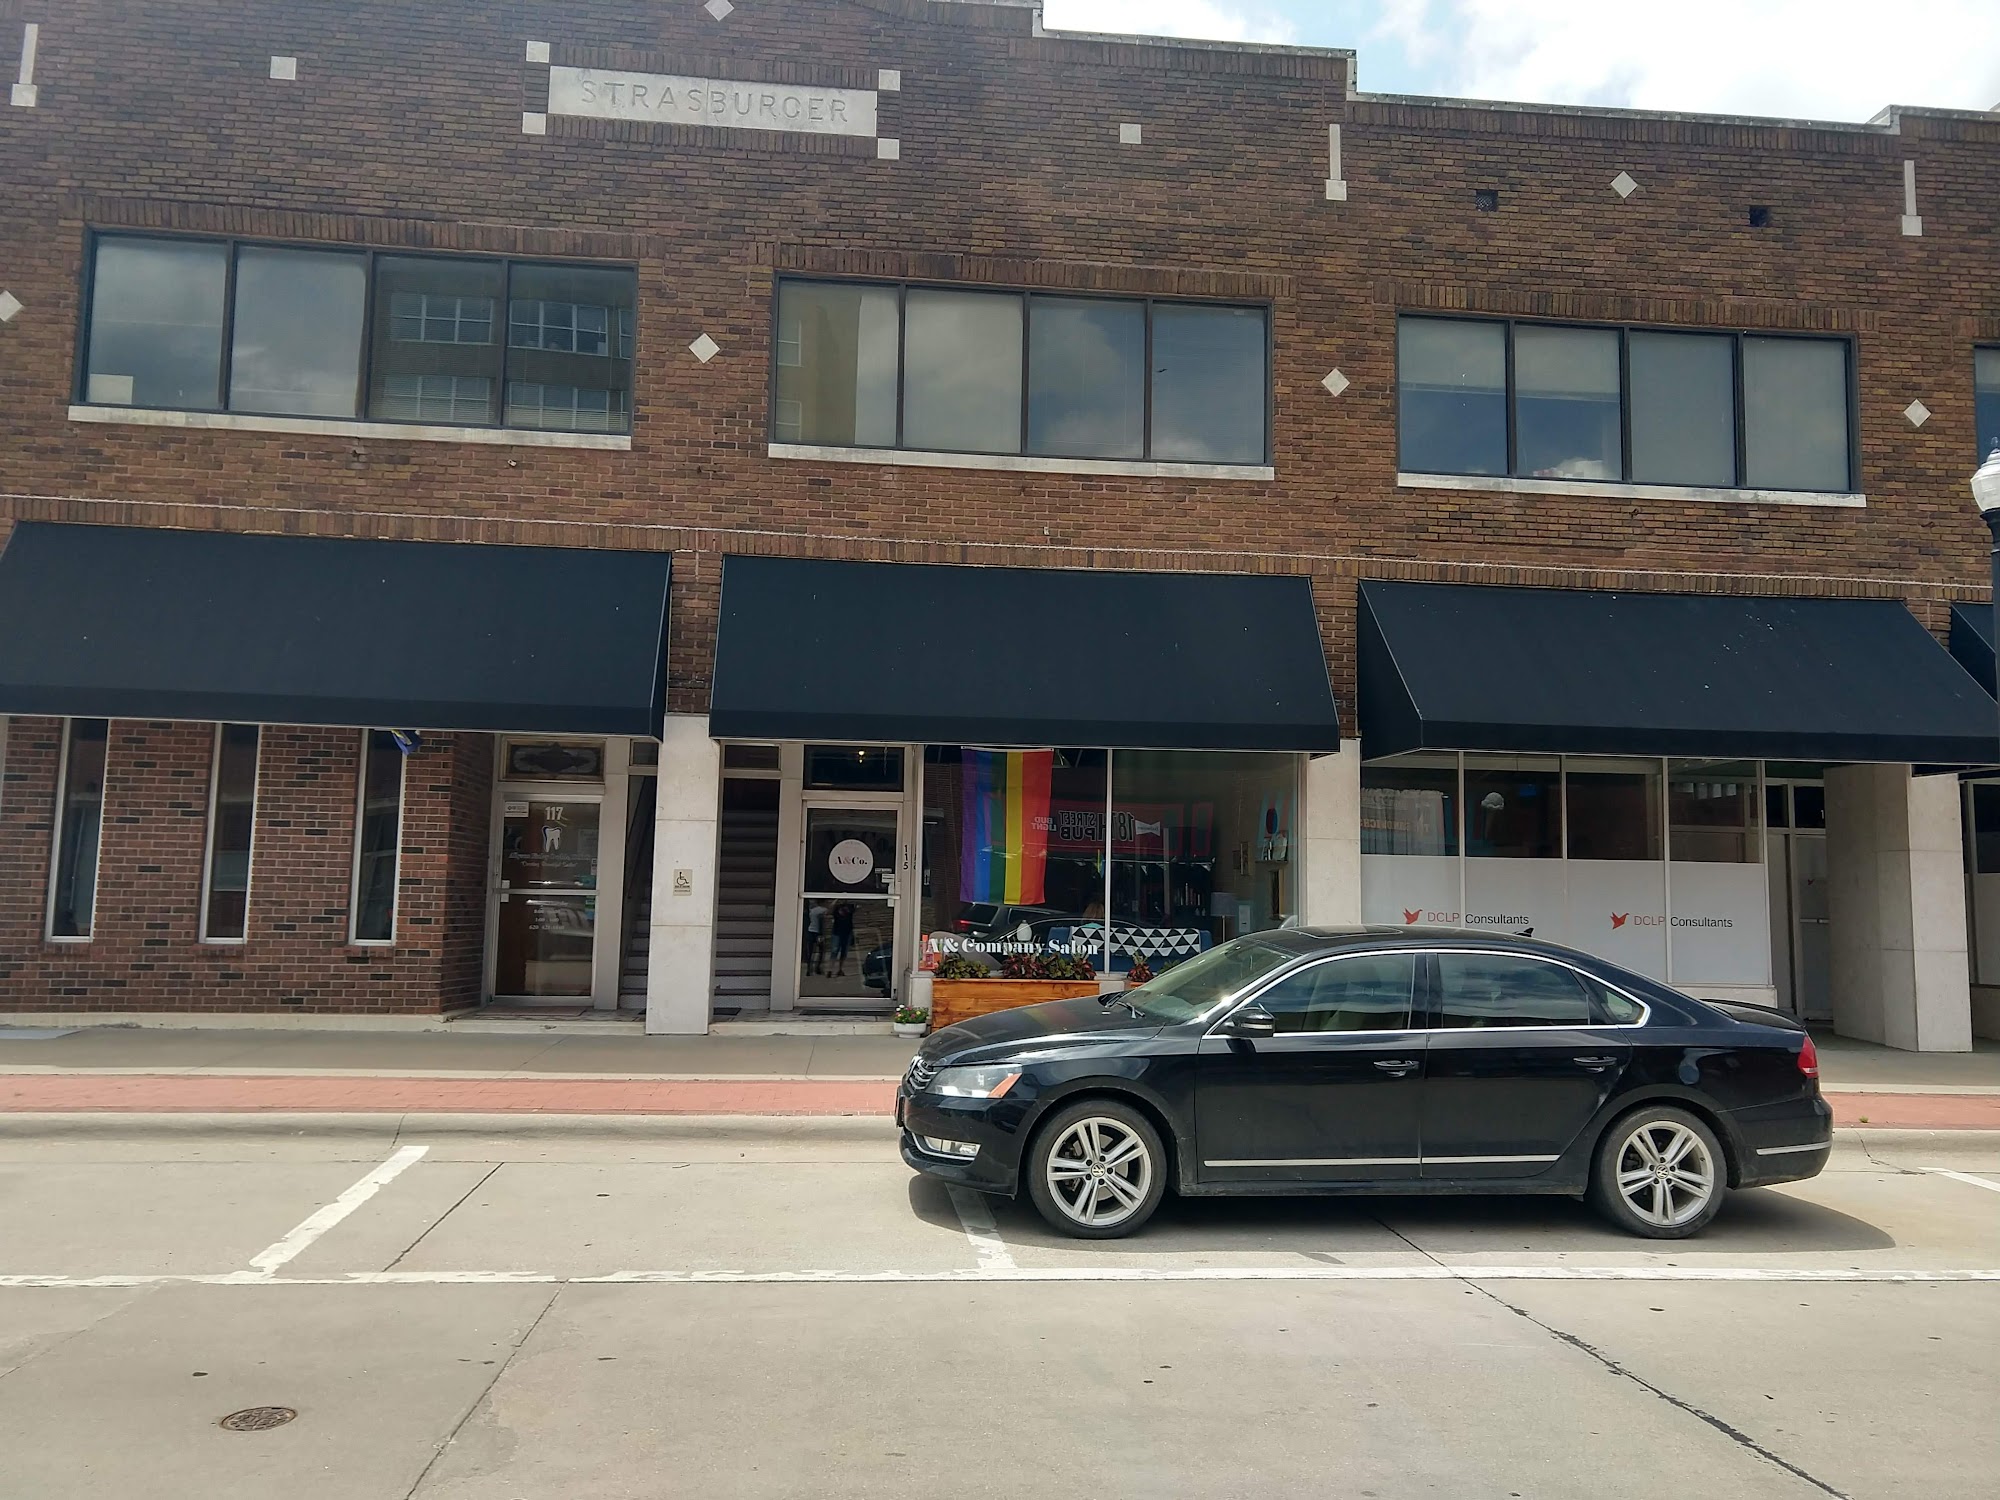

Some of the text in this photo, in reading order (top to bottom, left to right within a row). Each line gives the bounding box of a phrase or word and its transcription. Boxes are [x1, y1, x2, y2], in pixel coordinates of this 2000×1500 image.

[580, 79, 848, 122] STRASBURGER
[545, 806, 563, 820] 117
[834, 855, 868, 865] A&Co.
[1427, 911, 1530, 925] DCLP Consultants
[1634, 914, 1733, 928] DCLP Consultants
[961, 937, 1046, 956] Company
[1048, 938, 1099, 955] Salon
